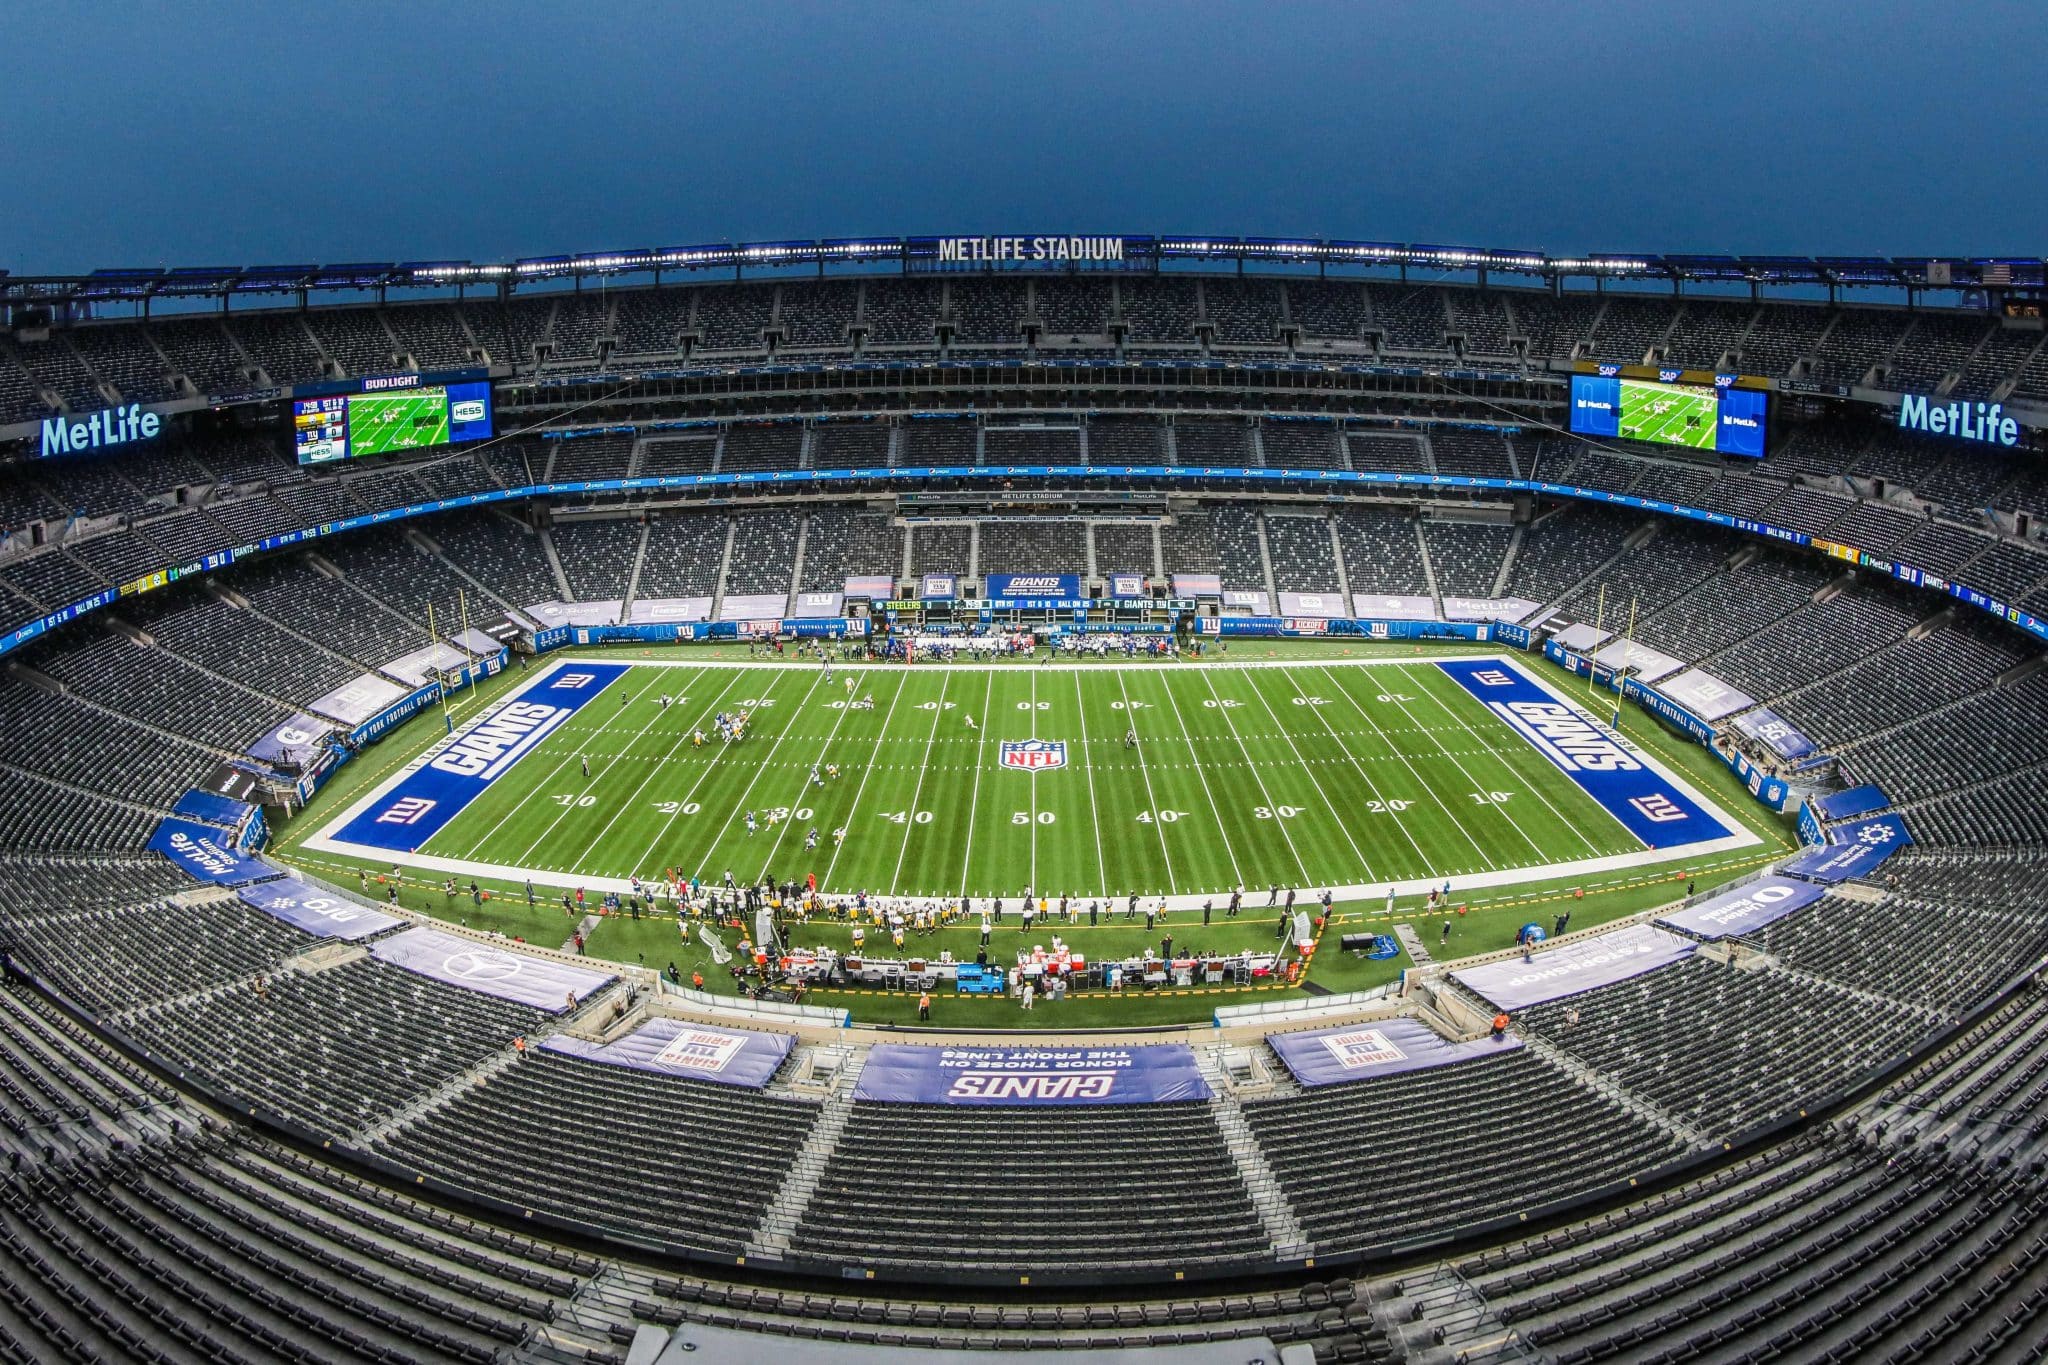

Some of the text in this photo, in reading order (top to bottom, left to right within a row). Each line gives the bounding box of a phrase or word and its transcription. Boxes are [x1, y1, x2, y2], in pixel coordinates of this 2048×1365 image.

[939, 237, 1123, 261] METLIFE STADIUM
[1598, 366, 1616, 376] SAP
[1659, 371, 1677, 381] SAP
[365, 375, 419, 390] BUD LIGHT
[1715, 376, 1732, 386] SAP
[455, 406, 482, 417] HESS
[1587, 401, 1612, 410] MetLife
[1732, 417, 1758, 427] MetLife
[1900, 394, 2019, 446] MetLife
[41, 403, 160, 457] MetLife
[311, 448, 330, 456] HESS
[235, 545, 254, 557] GIANTS
[178, 563, 202, 577] MetLife
[1869, 558, 1893, 573] MetLife
[1009, 577, 1060, 586] GIANTS
[1924, 574, 1944, 590] GIANTS
[886, 601, 921, 610] STEELERS
[1057, 600, 1071, 608] BALL
[1072, 600, 1081, 608] ON
[1124, 601, 1153, 609] GIANTS
[1456, 601, 1520, 610] MetLife
[1296, 621, 1322, 630] KICKOFF
[743, 699, 777, 707] 20
[923, 701, 957, 710] 40
[1017, 702, 1050, 710] 50
[1111, 701, 1147, 710] 40
[1203, 699, 1238, 708] 30
[1292, 697, 1326, 706] 20
[369, 719, 385, 735] YORK
[386, 703, 415, 723] FOOTBALL
[1506, 700, 1641, 771] GIANTS
[1574, 708, 1640, 752] END RACISM
[1759, 723, 1786, 740] 5G
[405, 761, 417, 771] IT
[420, 736, 455, 760] TAKES
[458, 724, 477, 737] ALL
[479, 712, 493, 723] OF
[430, 700, 559, 777] GIANTS
[1009, 752, 1060, 766] NFL
[560, 794, 597, 807] 10
[1470, 792, 1508, 804] 10
[661, 801, 701, 815] 20
[1253, 806, 1298, 819] 30
[1367, 799, 1411, 814] 20
[890, 811, 933, 824] 40
[1012, 813, 1055, 825] 50
[1136, 810, 1180, 823] 40
[171, 832, 235, 875] MetLife
[198, 837, 239, 866] Stadium
[302, 898, 359, 922] nrg
[1699, 898, 1750, 921] Rentals
[1715, 902, 1766, 925] United
[691, 1034, 734, 1047] PRIDE
[1335, 1033, 1375, 1046] PRIDE
[665, 1053, 720, 1069] GIANTS
[941, 1051, 1130, 1060] THE FRONT LINES
[1348, 1051, 1398, 1066] GIANTS
[939, 1060, 1132, 1068] HONOR THOSE ON
[952, 1075, 1115, 1098] GIANTS
